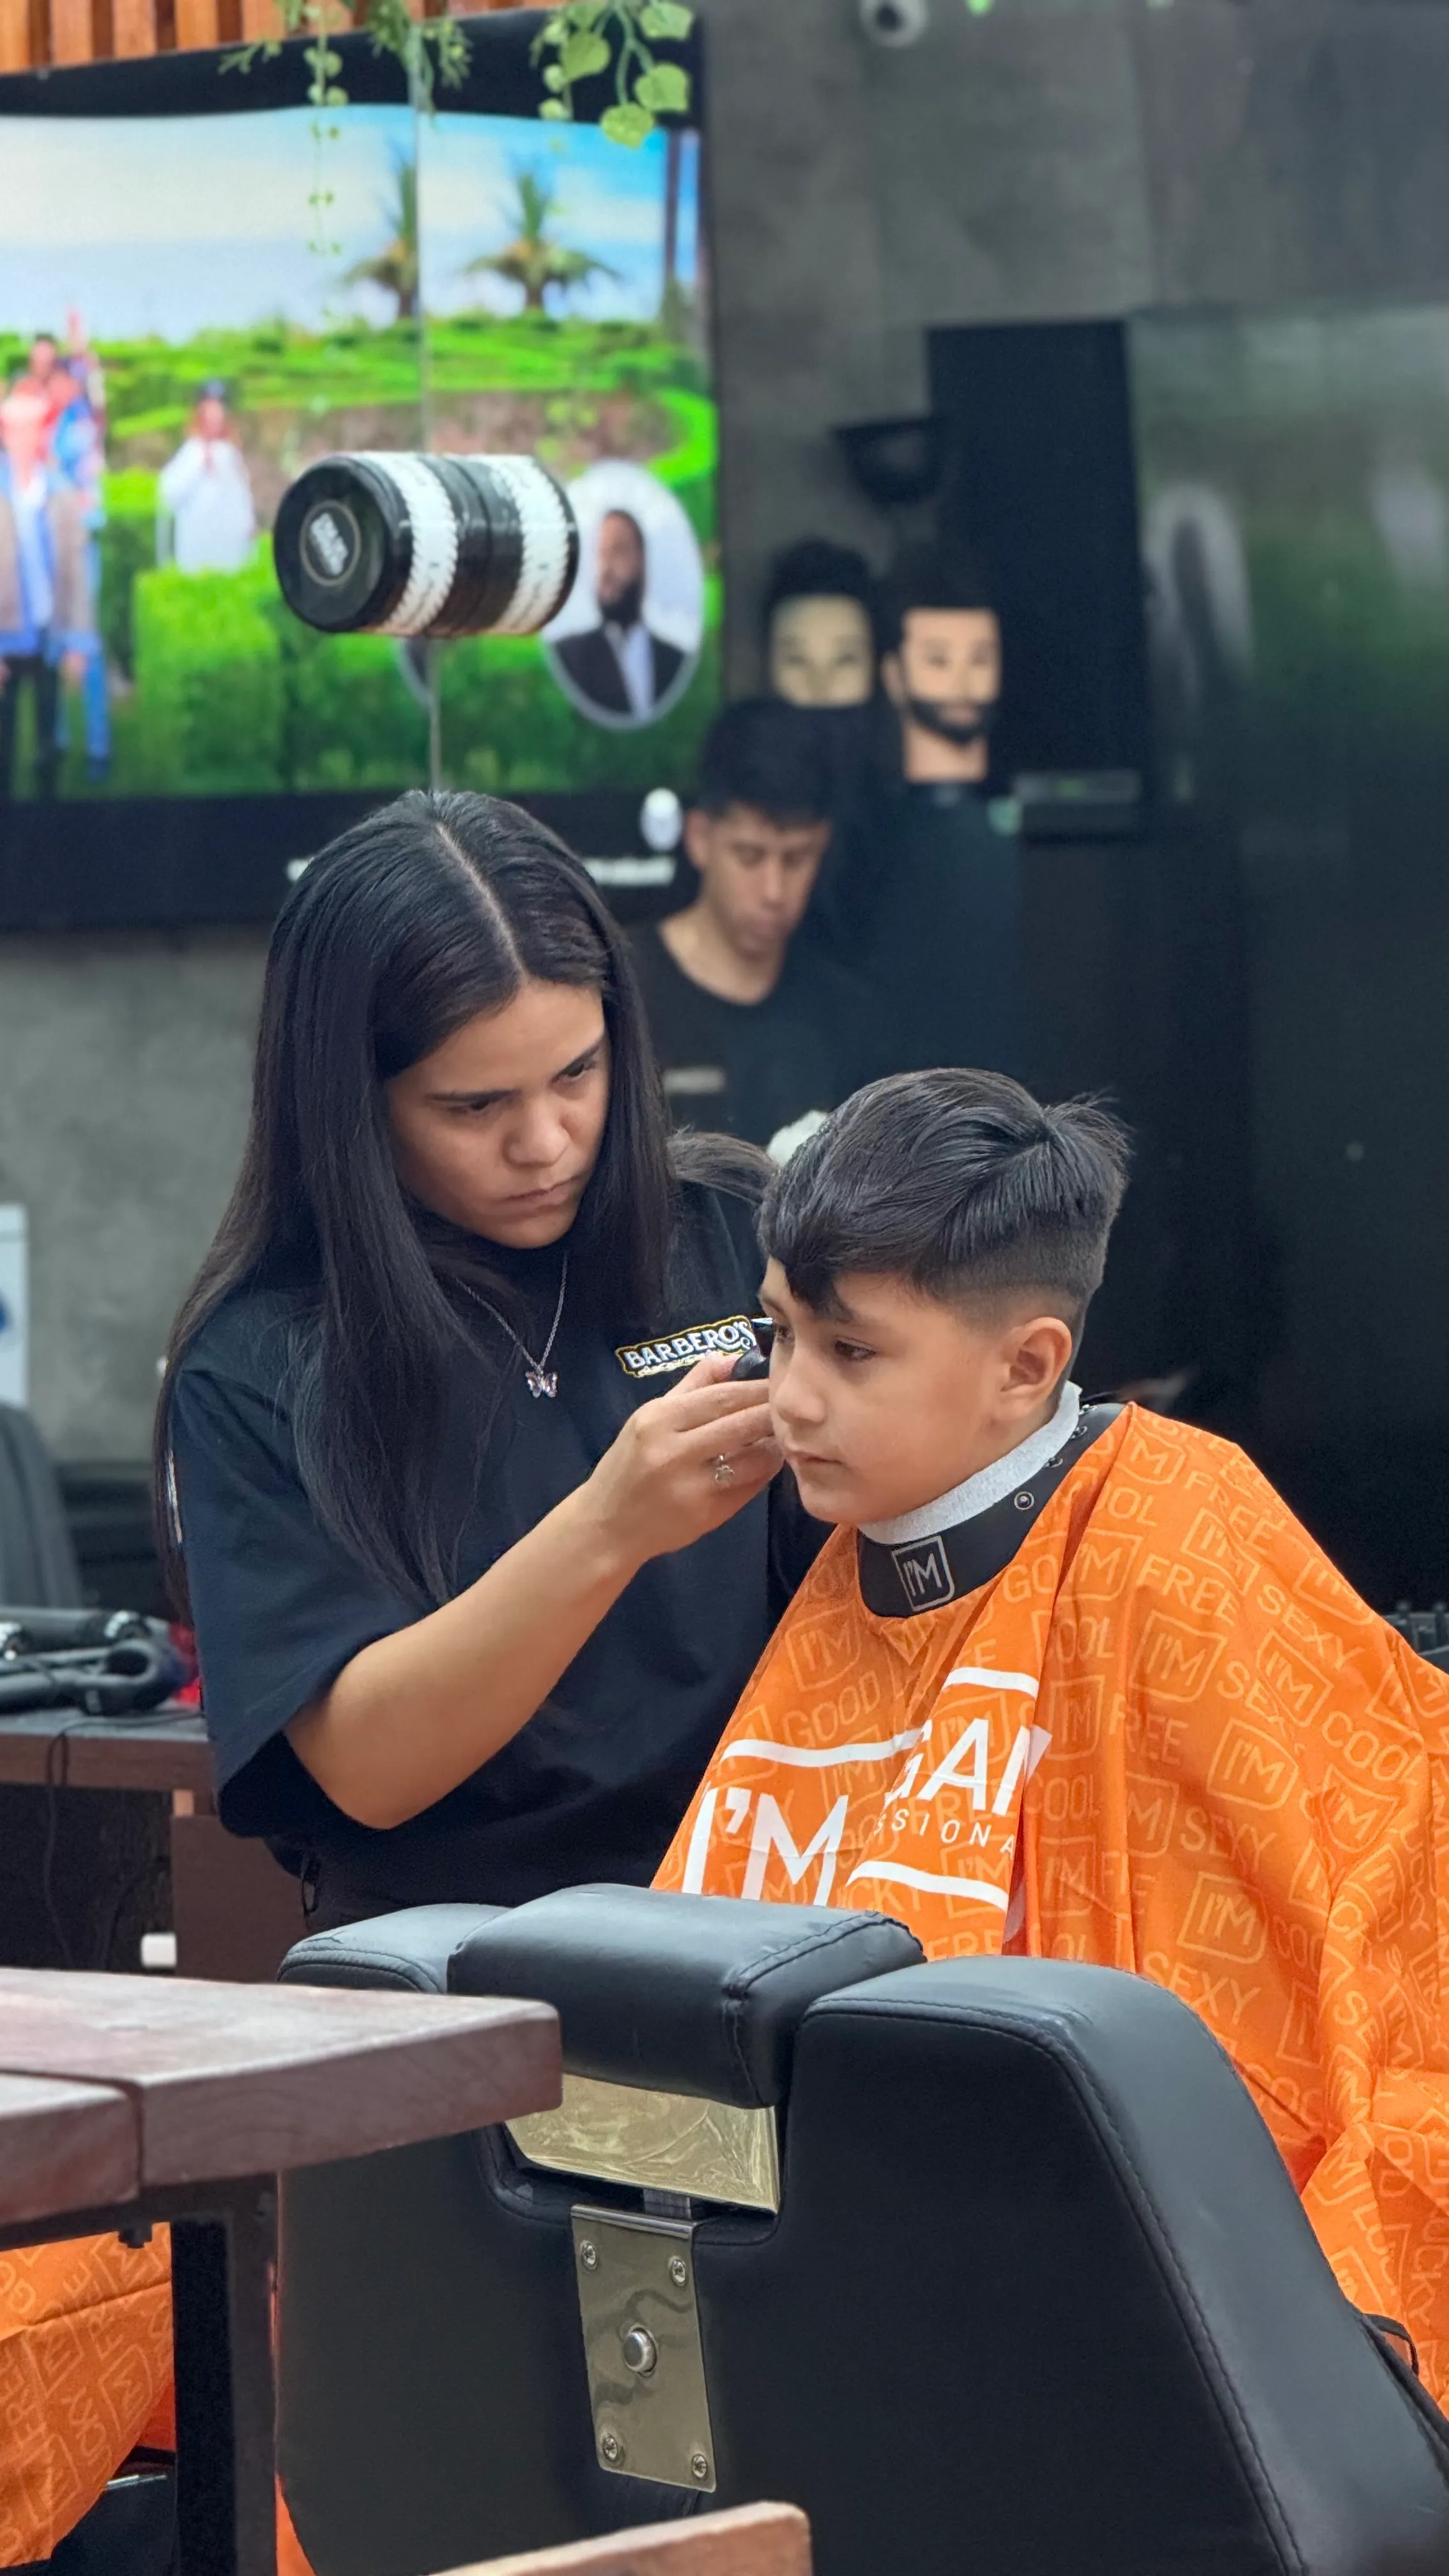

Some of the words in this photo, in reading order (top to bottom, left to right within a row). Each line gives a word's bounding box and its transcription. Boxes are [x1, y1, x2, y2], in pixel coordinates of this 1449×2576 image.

[624, 1321, 757, 1370] BARBERO'S
[903, 1552, 942, 1596] I'M
[1135, 1554, 1241, 1627] FREE
[1146, 1632, 1206, 1687] I'M
[1257, 1584, 1365, 1671] SEXY
[782, 1671, 880, 1748] GOOD
[1266, 1651, 1314, 1712] I'M
[1223, 1738, 1285, 1795] I'M
[1322, 1710, 1423, 1786] COOL
[1179, 1805, 1278, 1873] SEXY
[1197, 1892, 1258, 1946] I'M
[1142, 1951, 1262, 2026] SEXY
